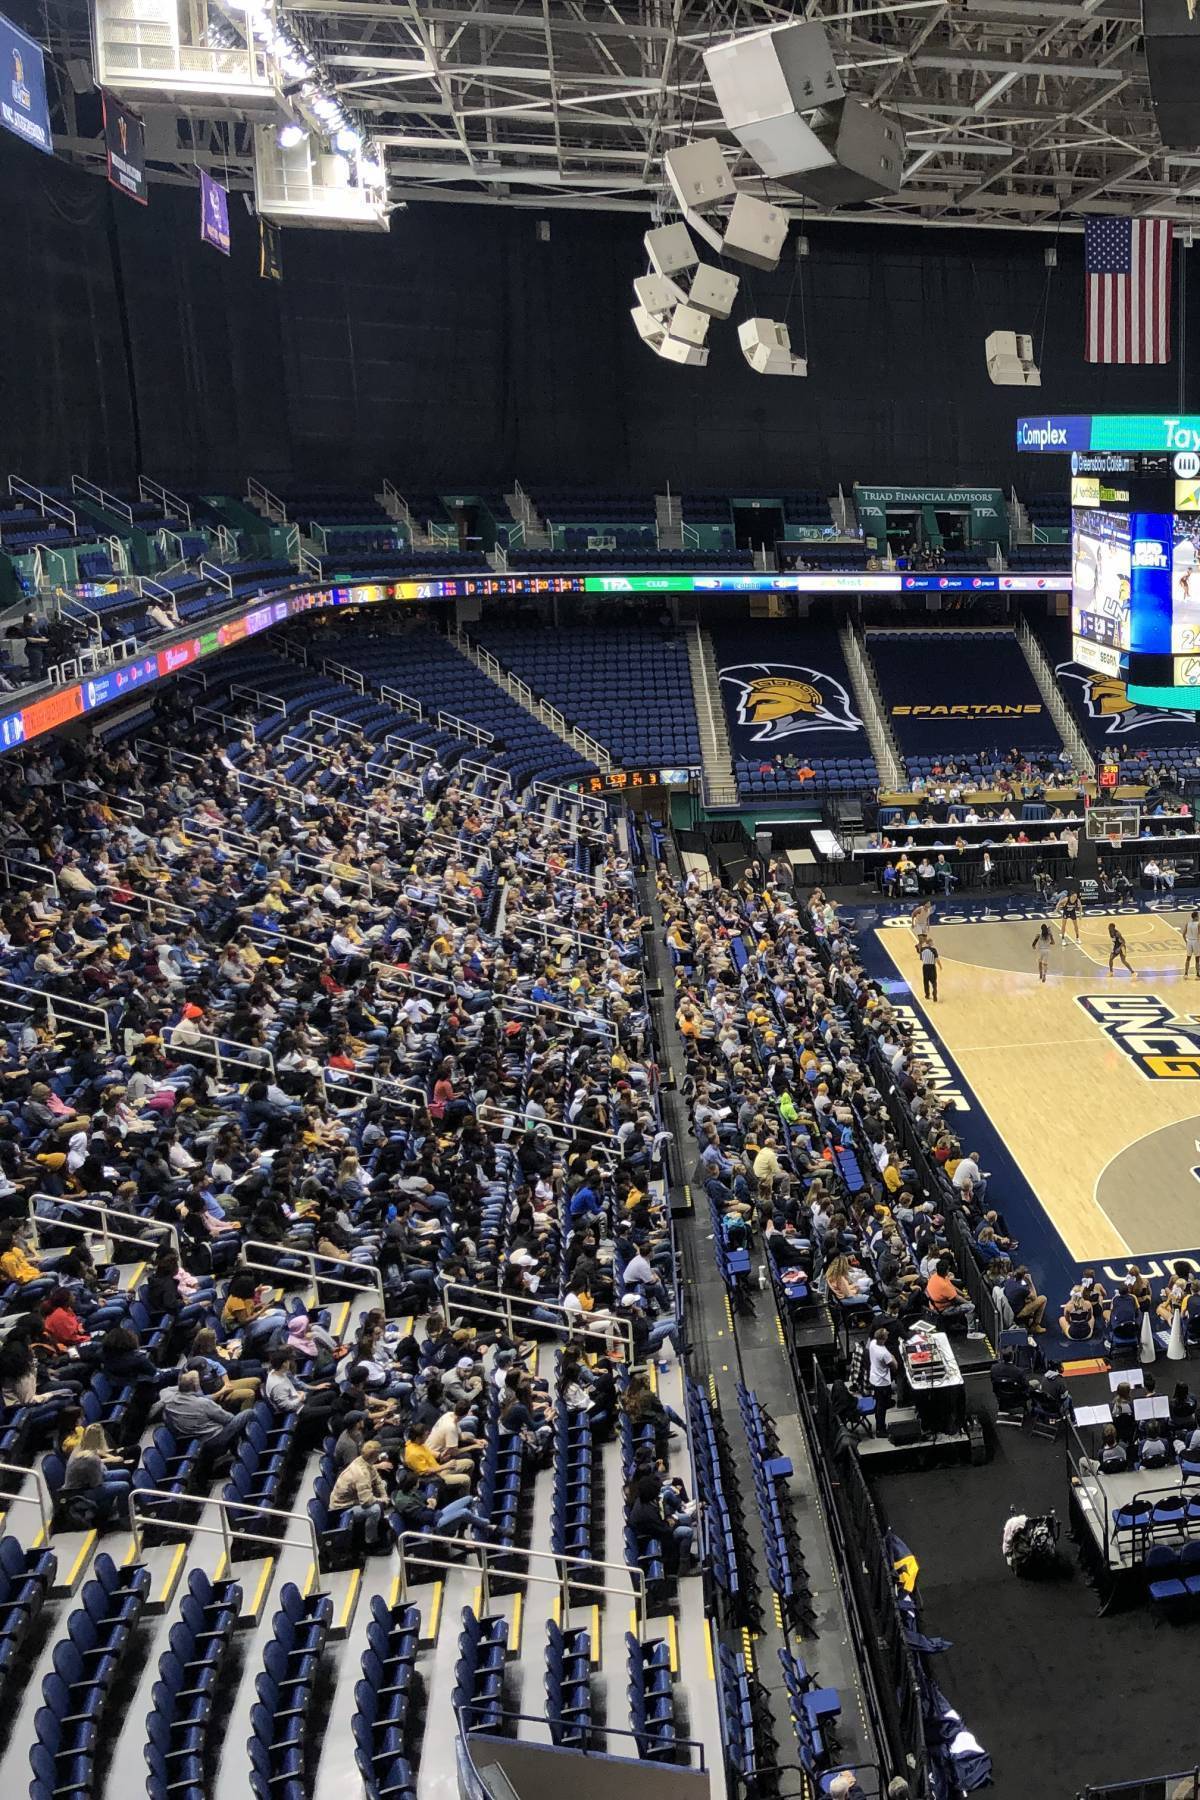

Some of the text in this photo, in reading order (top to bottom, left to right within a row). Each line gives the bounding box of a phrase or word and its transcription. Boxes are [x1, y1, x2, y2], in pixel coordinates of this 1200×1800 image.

[1022, 421, 1067, 450] Complex
[863, 491, 992, 501] TRIAD FINANCIAL ADVISORS
[859, 507, 883, 516] TFA
[974, 508, 998, 517] TFA
[1135, 542, 1163, 554] BUD
[1132, 555, 1167, 567] LIGHT
[538, 581, 549, 589] 20
[601, 579, 669, 591] TFA CLUB
[416, 586, 431, 599] 24
[892, 704, 1042, 715] SPARTANS
[1104, 765, 1118, 773] 5:30
[633, 777, 643, 785] 24
[1103, 772, 1116, 785] 20
[1080, 879, 1099, 887] TFA
